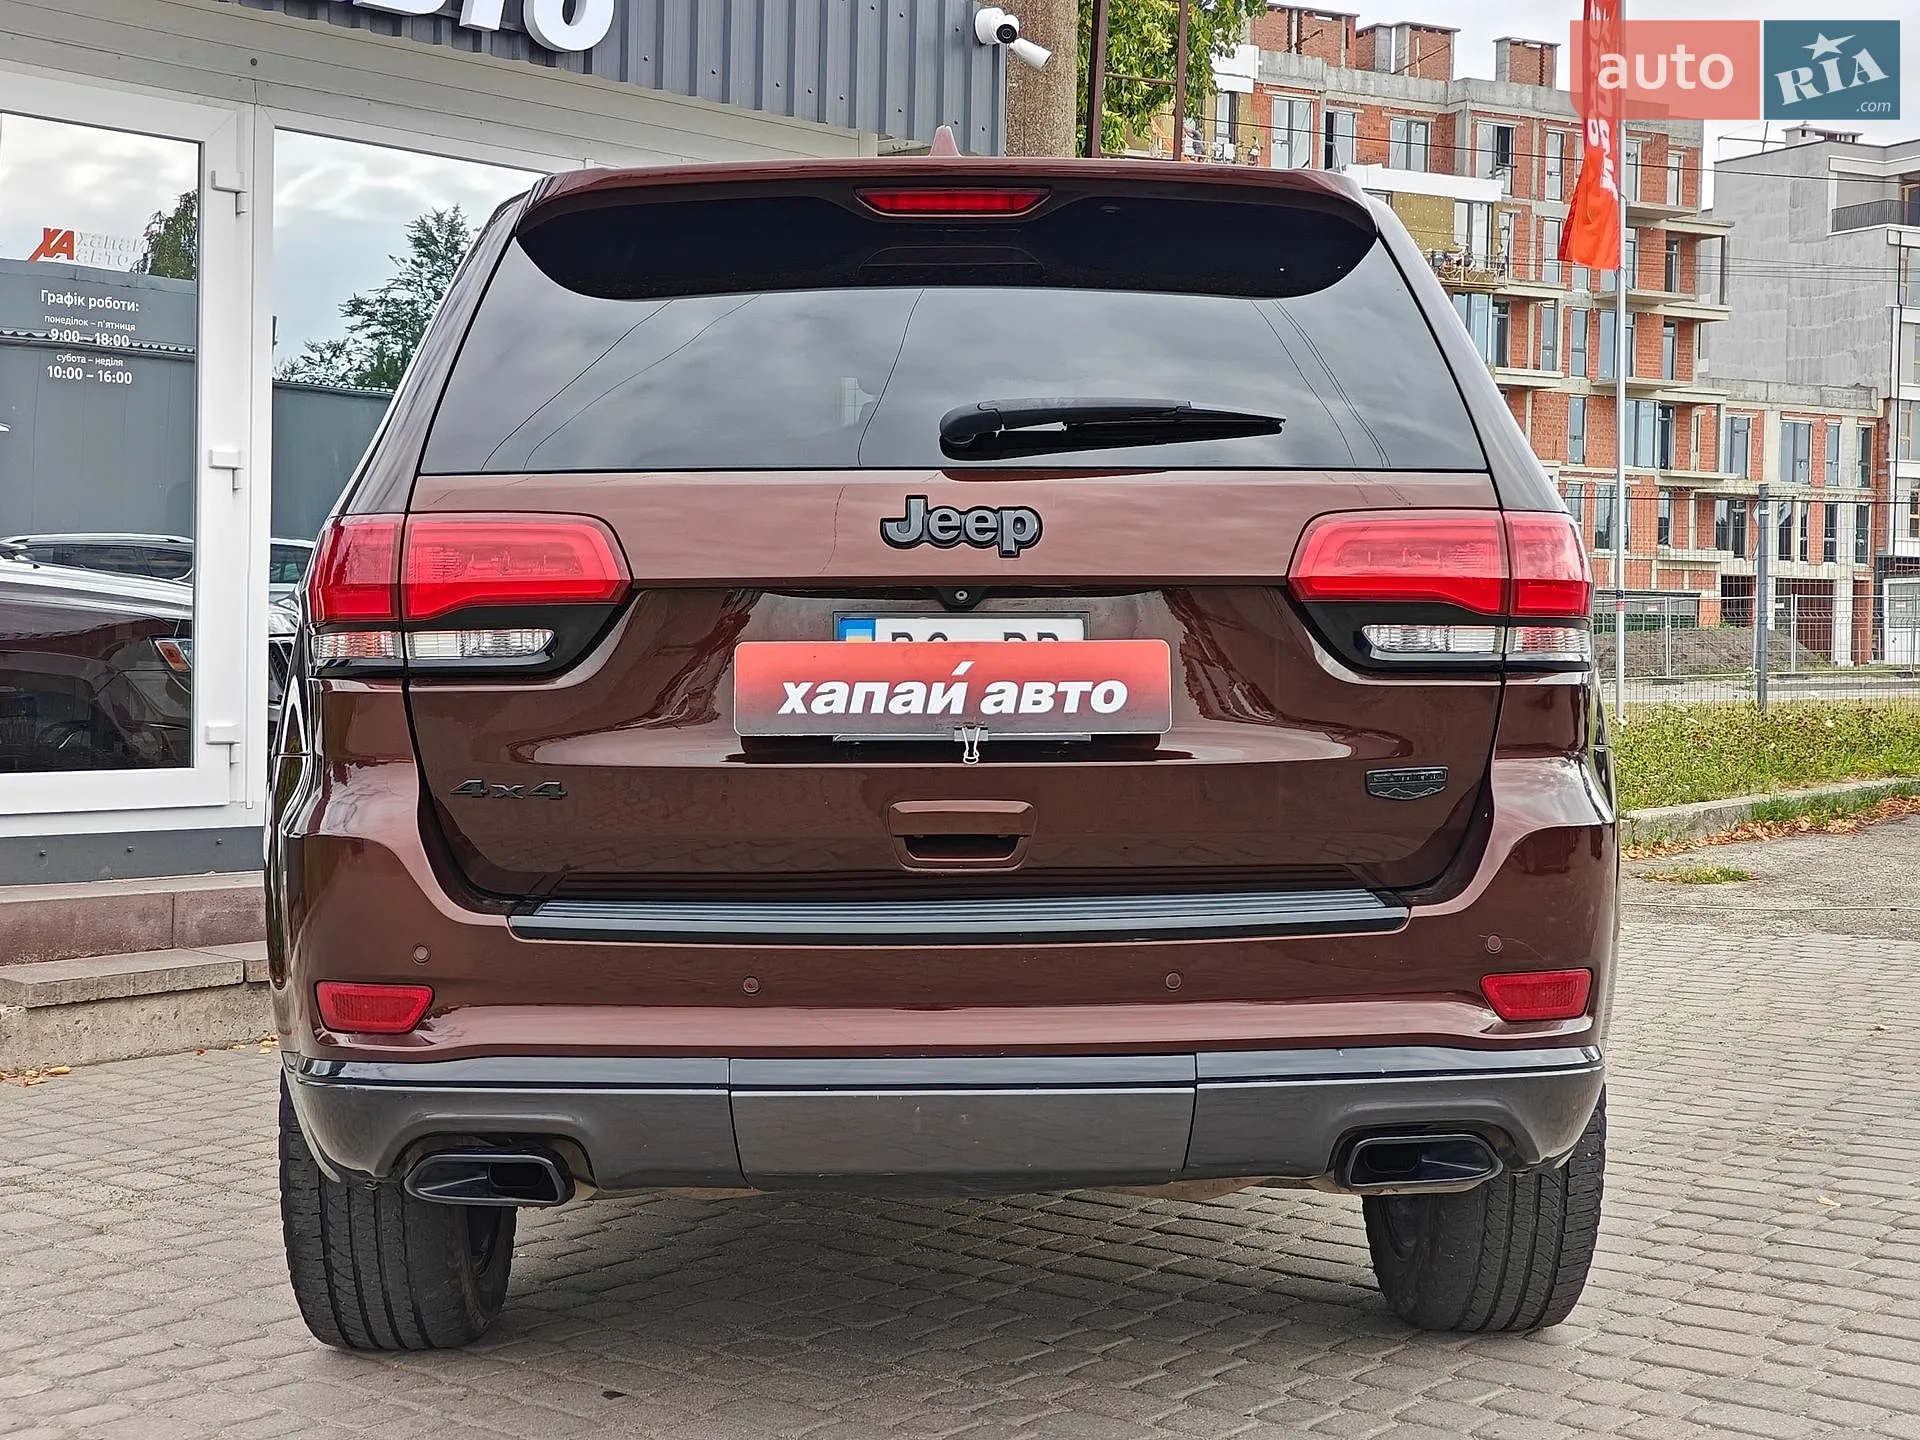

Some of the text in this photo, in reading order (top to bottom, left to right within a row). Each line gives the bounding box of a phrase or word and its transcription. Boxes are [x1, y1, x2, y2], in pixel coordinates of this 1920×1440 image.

[41, 289, 140, 312] Графік роботи:
[44, 315, 88, 327] понеділок
[50, 328, 80, 343] 9:00
[94, 332, 130, 347] 18:00
[56, 353, 87, 364] субота
[95, 357, 124, 367] неділя
[47, 365, 83, 380] 10:00
[97, 369, 133, 384] 16:00
[881, 496, 1042, 557] Jeep
[777, 661, 1129, 715] хапай авто
